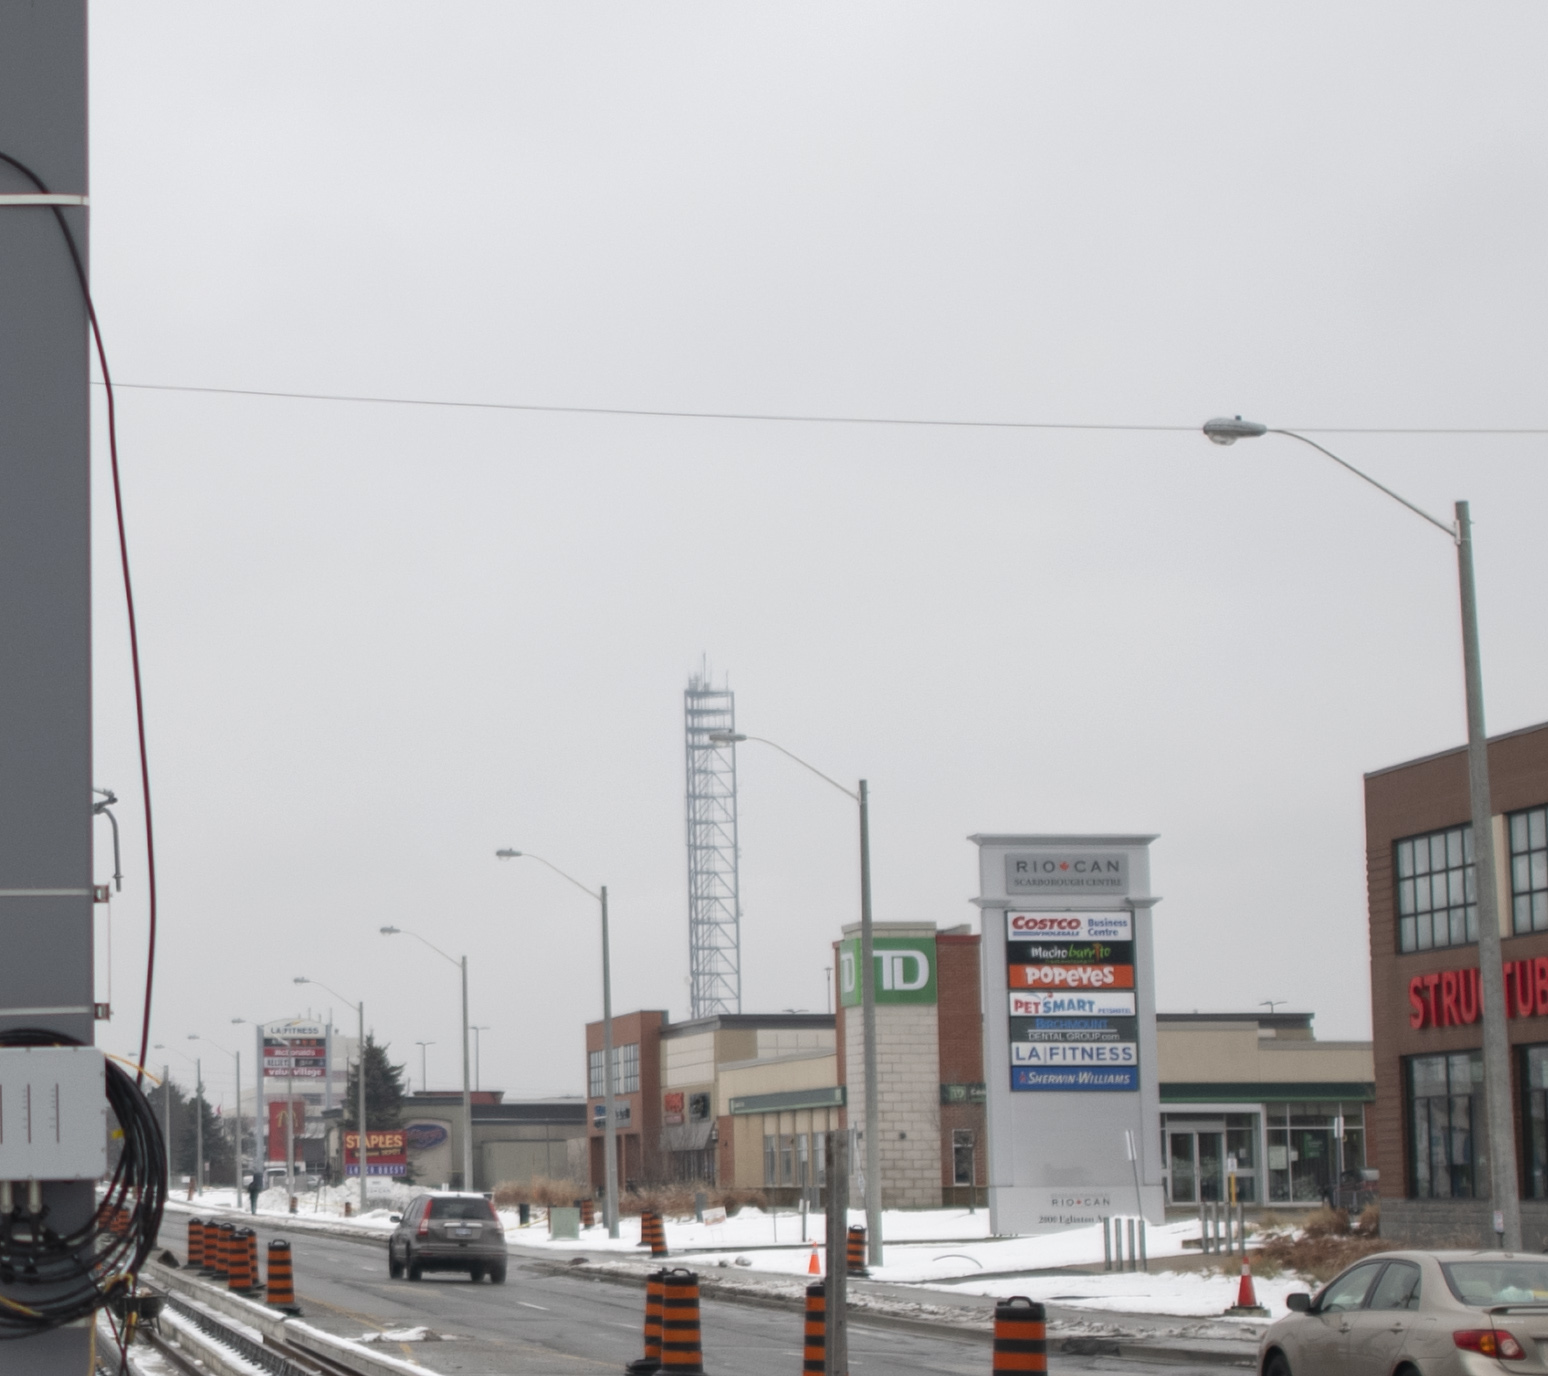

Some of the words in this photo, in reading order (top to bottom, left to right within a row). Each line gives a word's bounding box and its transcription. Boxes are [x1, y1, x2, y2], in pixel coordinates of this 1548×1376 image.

[1016, 860, 1055, 873] RIO
[1074, 860, 1120, 873] CAN
[1014, 878, 1085, 887] SCARBOROUGH
[1086, 878, 1122, 886] CENTRE
[1012, 916, 1082, 930] COSTCO
[1088, 918, 1128, 927] Business
[1088, 928, 1119, 937] Centre
[872, 950, 930, 991] TD
[1035, 1018, 1108, 1030] BIRCHMOUNT
[1028, 1032, 1063, 1041] DENTAL
